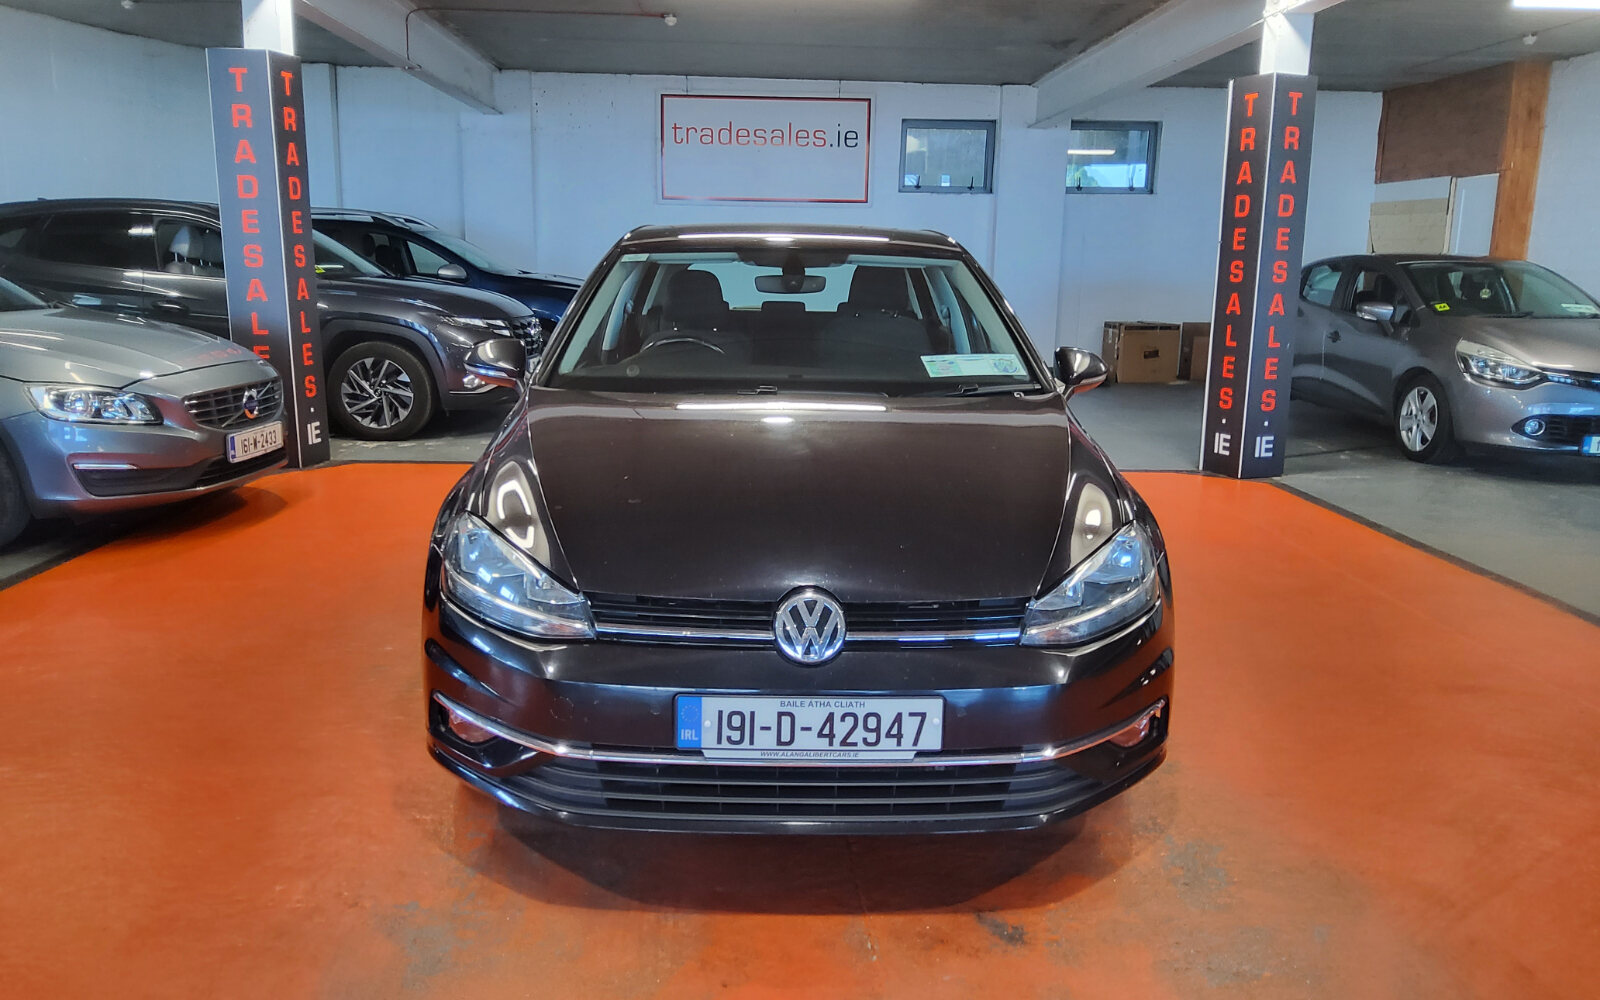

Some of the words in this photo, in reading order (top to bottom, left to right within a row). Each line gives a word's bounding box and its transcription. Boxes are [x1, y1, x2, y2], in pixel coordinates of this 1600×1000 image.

[671, 121, 859, 148] tradesales.ie
[240, 430, 277, 454] 161-W-2433
[780, 700, 806, 708] BAILE
[833, 700, 866, 709] CLIATH
[680, 728, 699, 741] IRL
[716, 709, 928, 747] 191-D-42947
